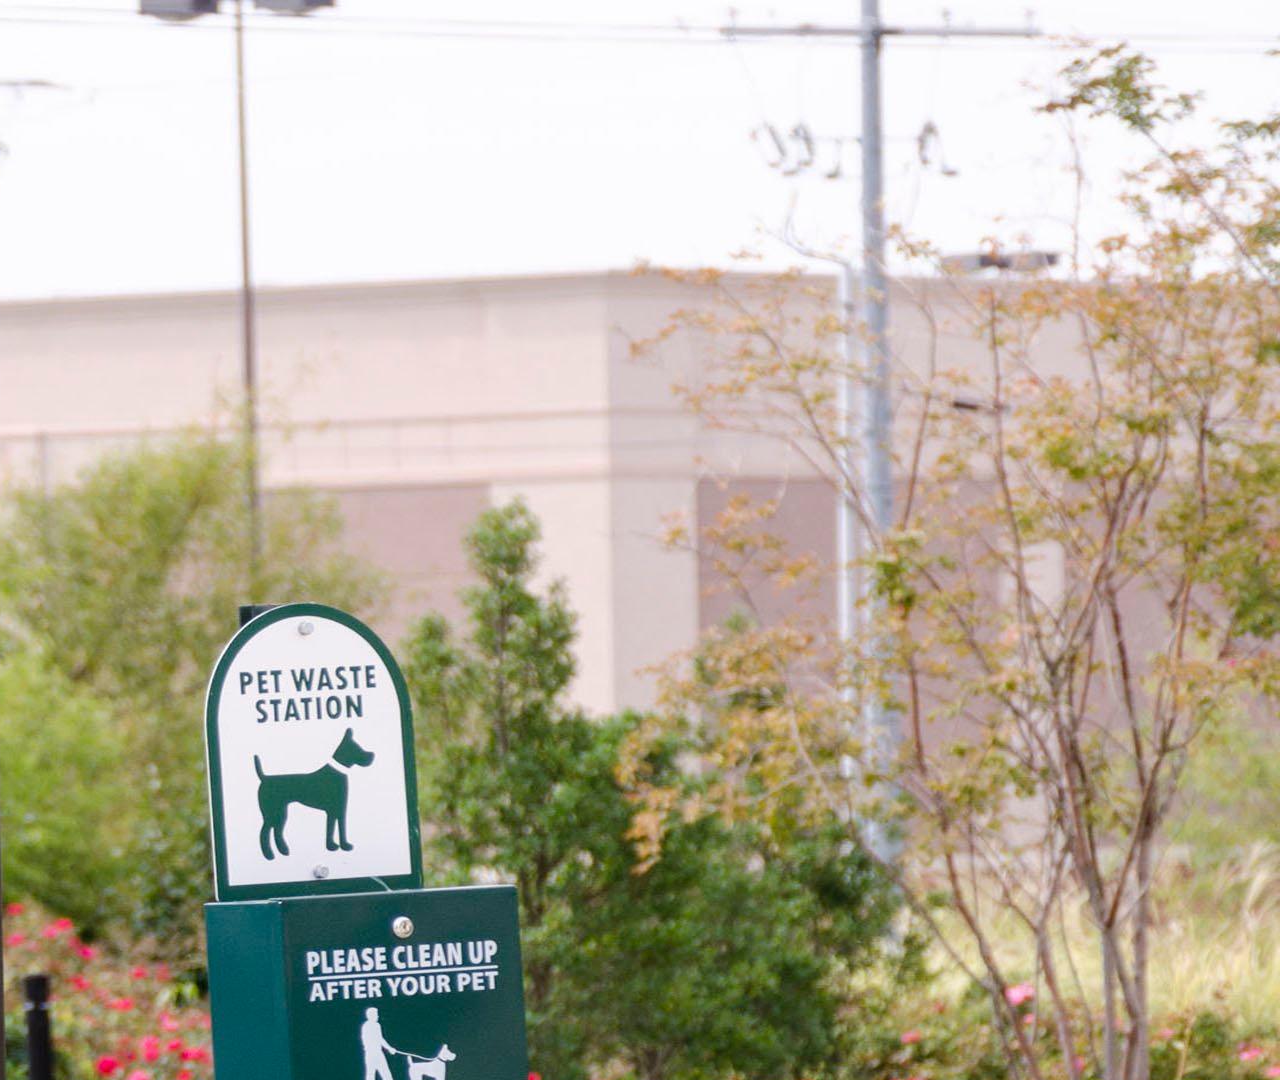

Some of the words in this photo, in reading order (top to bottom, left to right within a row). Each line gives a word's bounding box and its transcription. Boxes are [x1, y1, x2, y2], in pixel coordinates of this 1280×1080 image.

[239, 670, 282, 695] PET
[291, 664, 378, 692] WASTE
[255, 694, 363, 723] STATION
[306, 946, 388, 975] PLEASE
[392, 942, 463, 969] CLEAN
[467, 939, 498, 964] UP
[309, 978, 383, 1002] AFTER
[387, 974, 452, 997] YOUR
[457, 970, 499, 992] PET
